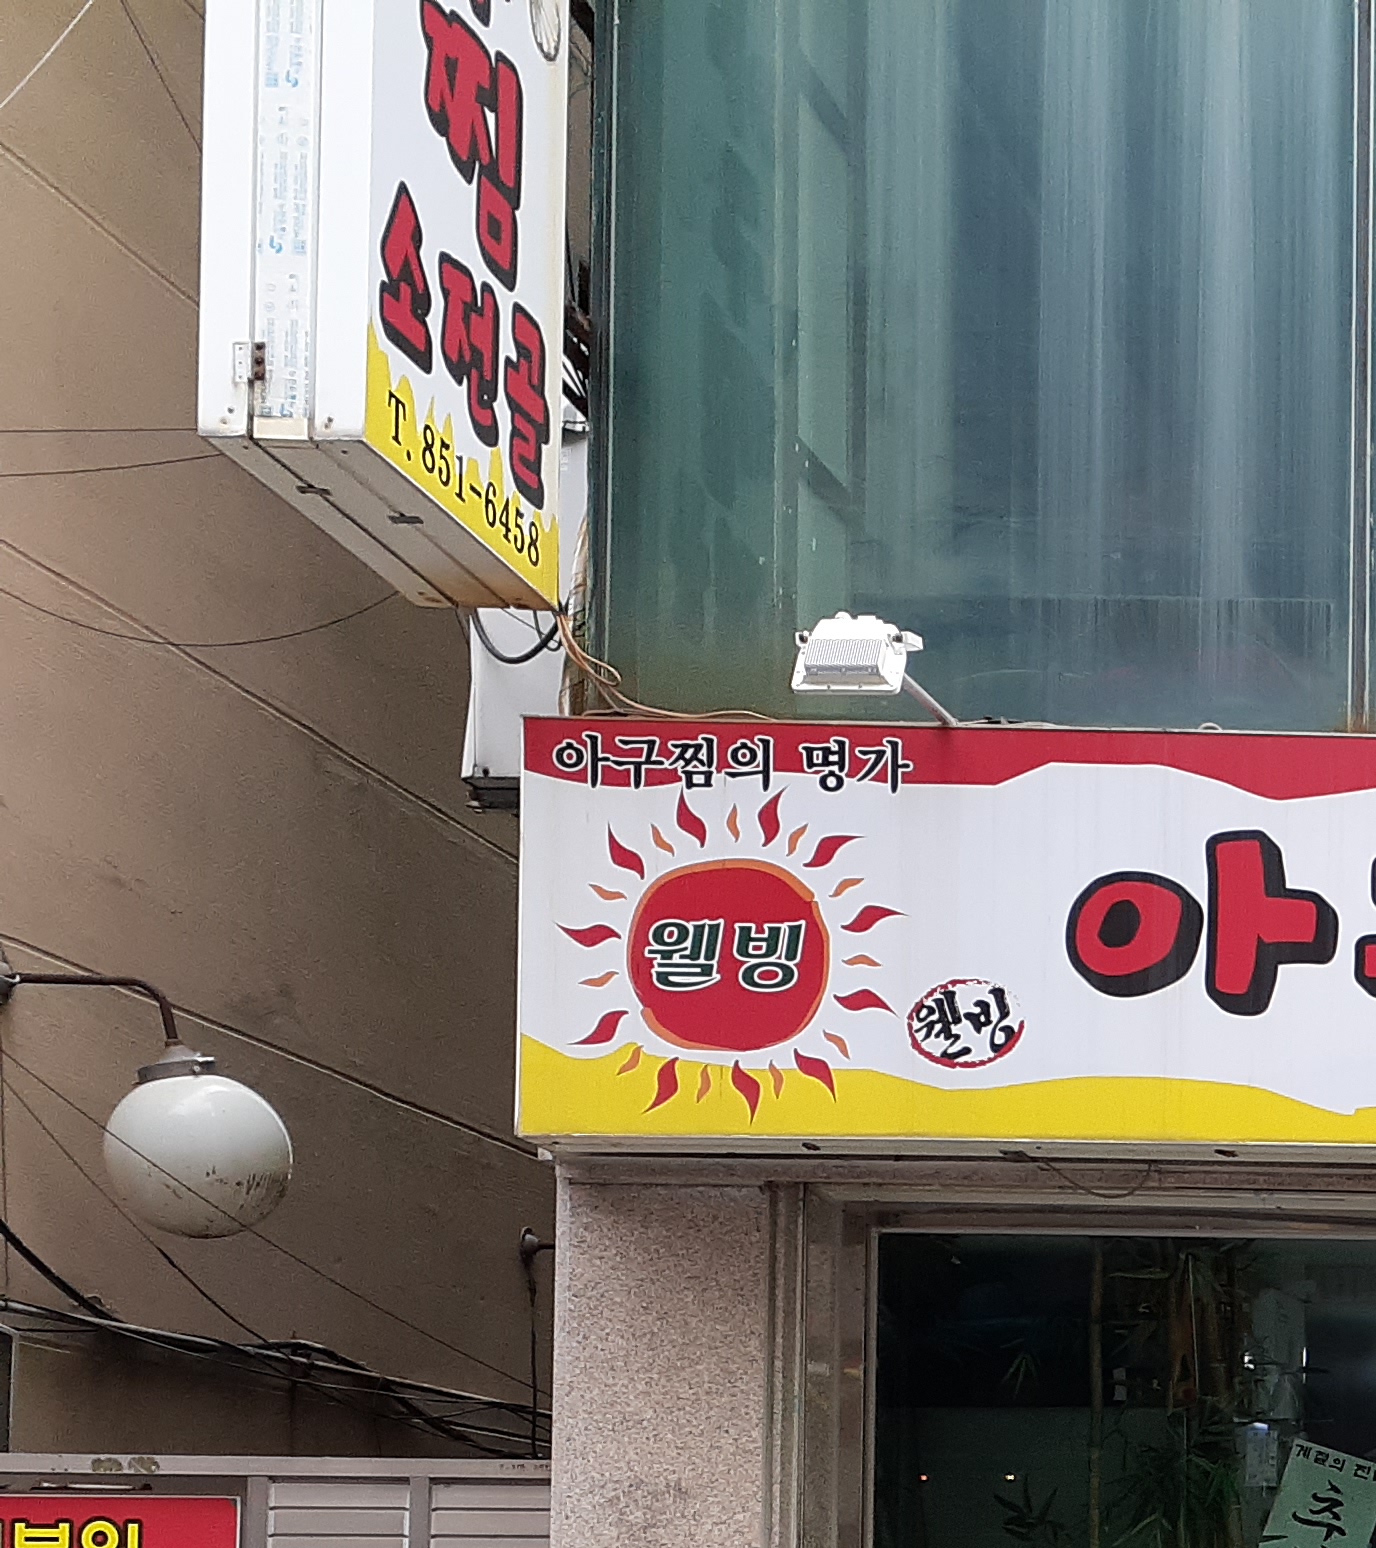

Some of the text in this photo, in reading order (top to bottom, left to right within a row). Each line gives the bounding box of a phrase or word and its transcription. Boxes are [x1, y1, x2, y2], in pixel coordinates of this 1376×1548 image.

[380, 181, 551, 511] 소전골
[421, 429, 541, 568] 851-6458
[553, 731, 914, 795] 아구찜의 명가
[645, 917, 809, 993] 웰빙
